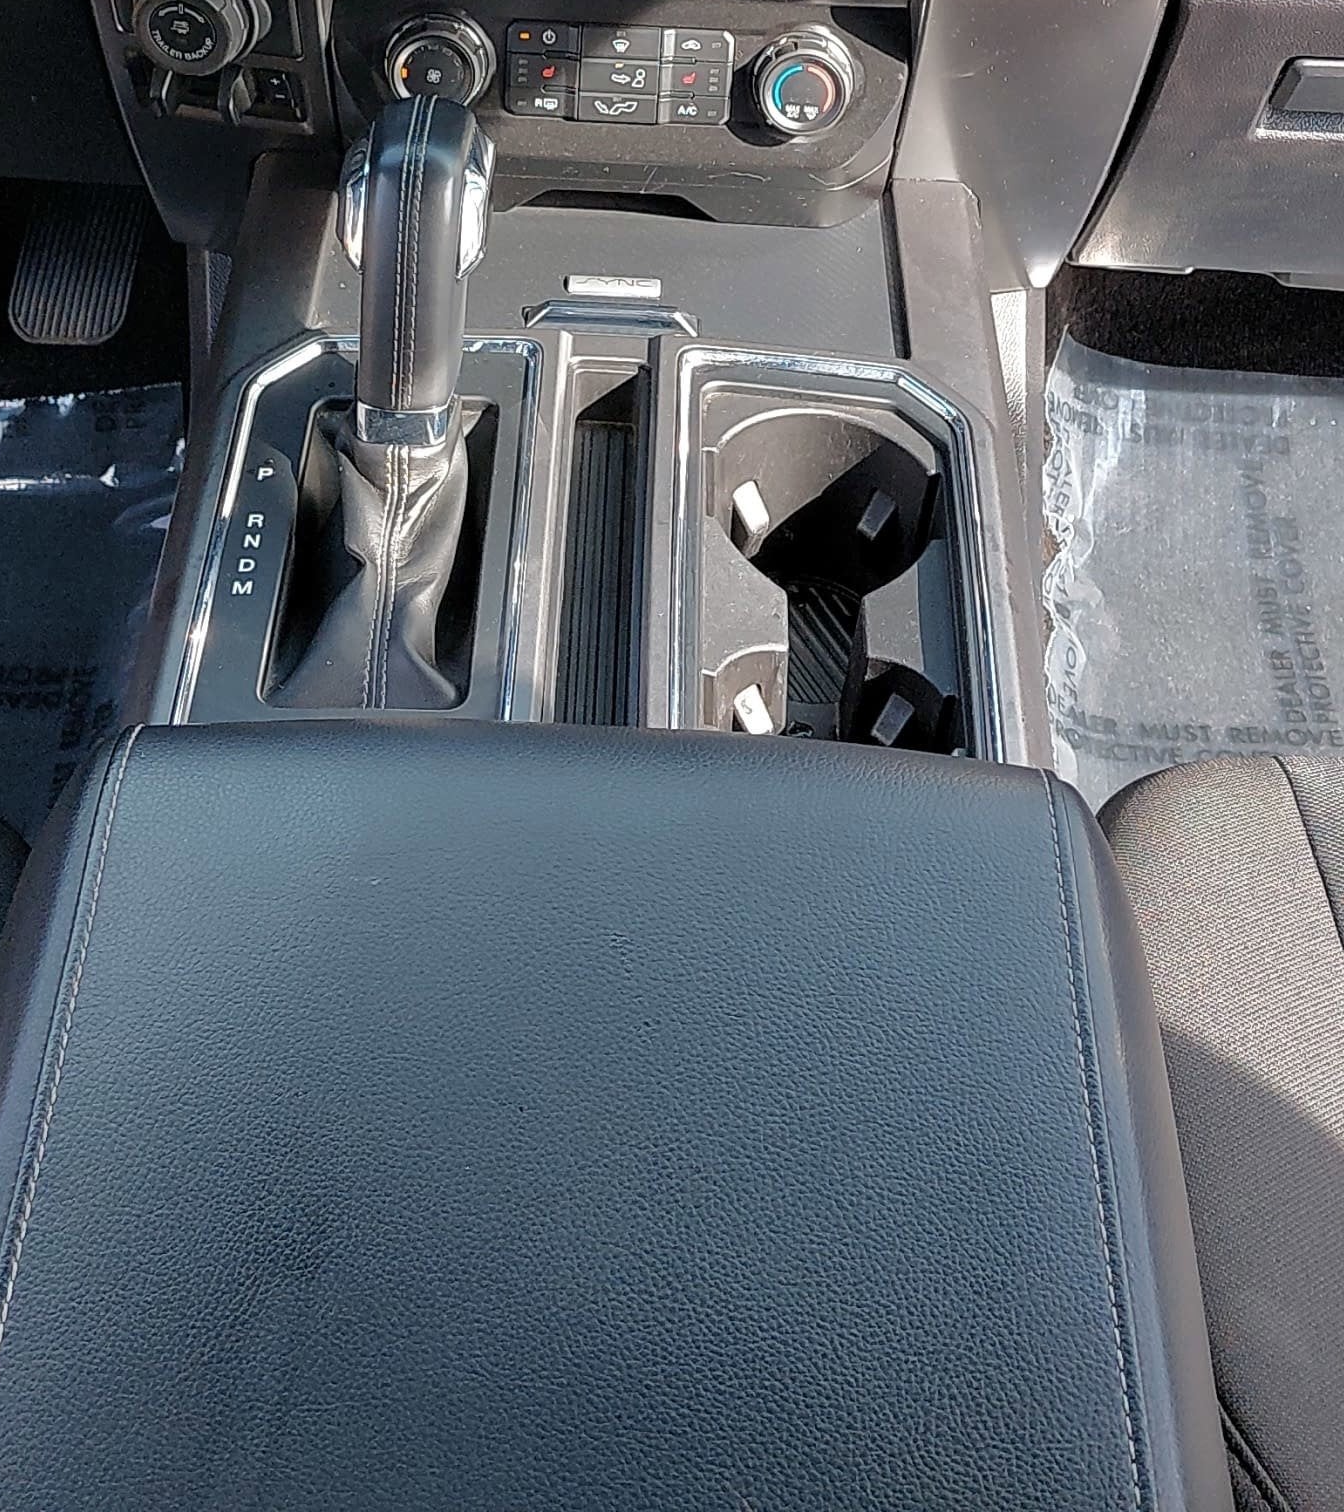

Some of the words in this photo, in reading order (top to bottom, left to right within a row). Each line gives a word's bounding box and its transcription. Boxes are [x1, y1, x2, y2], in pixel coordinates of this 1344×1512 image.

[677, 105, 698, 117] A/C
[575, 277, 655, 288] SYNC
[257, 466, 274, 481] P
[247, 514, 264, 528] R
[243, 534, 261, 548] N
[1270, 516, 1307, 595] COVER
[238, 558, 256, 572] D
[231, 580, 253, 595] M
[1254, 573, 1284, 637] MUST
[1287, 603, 1340, 726] PROTECTIVE
[1268, 648, 1307, 725] DEALER
[1139, 722, 1212, 743] MUST
